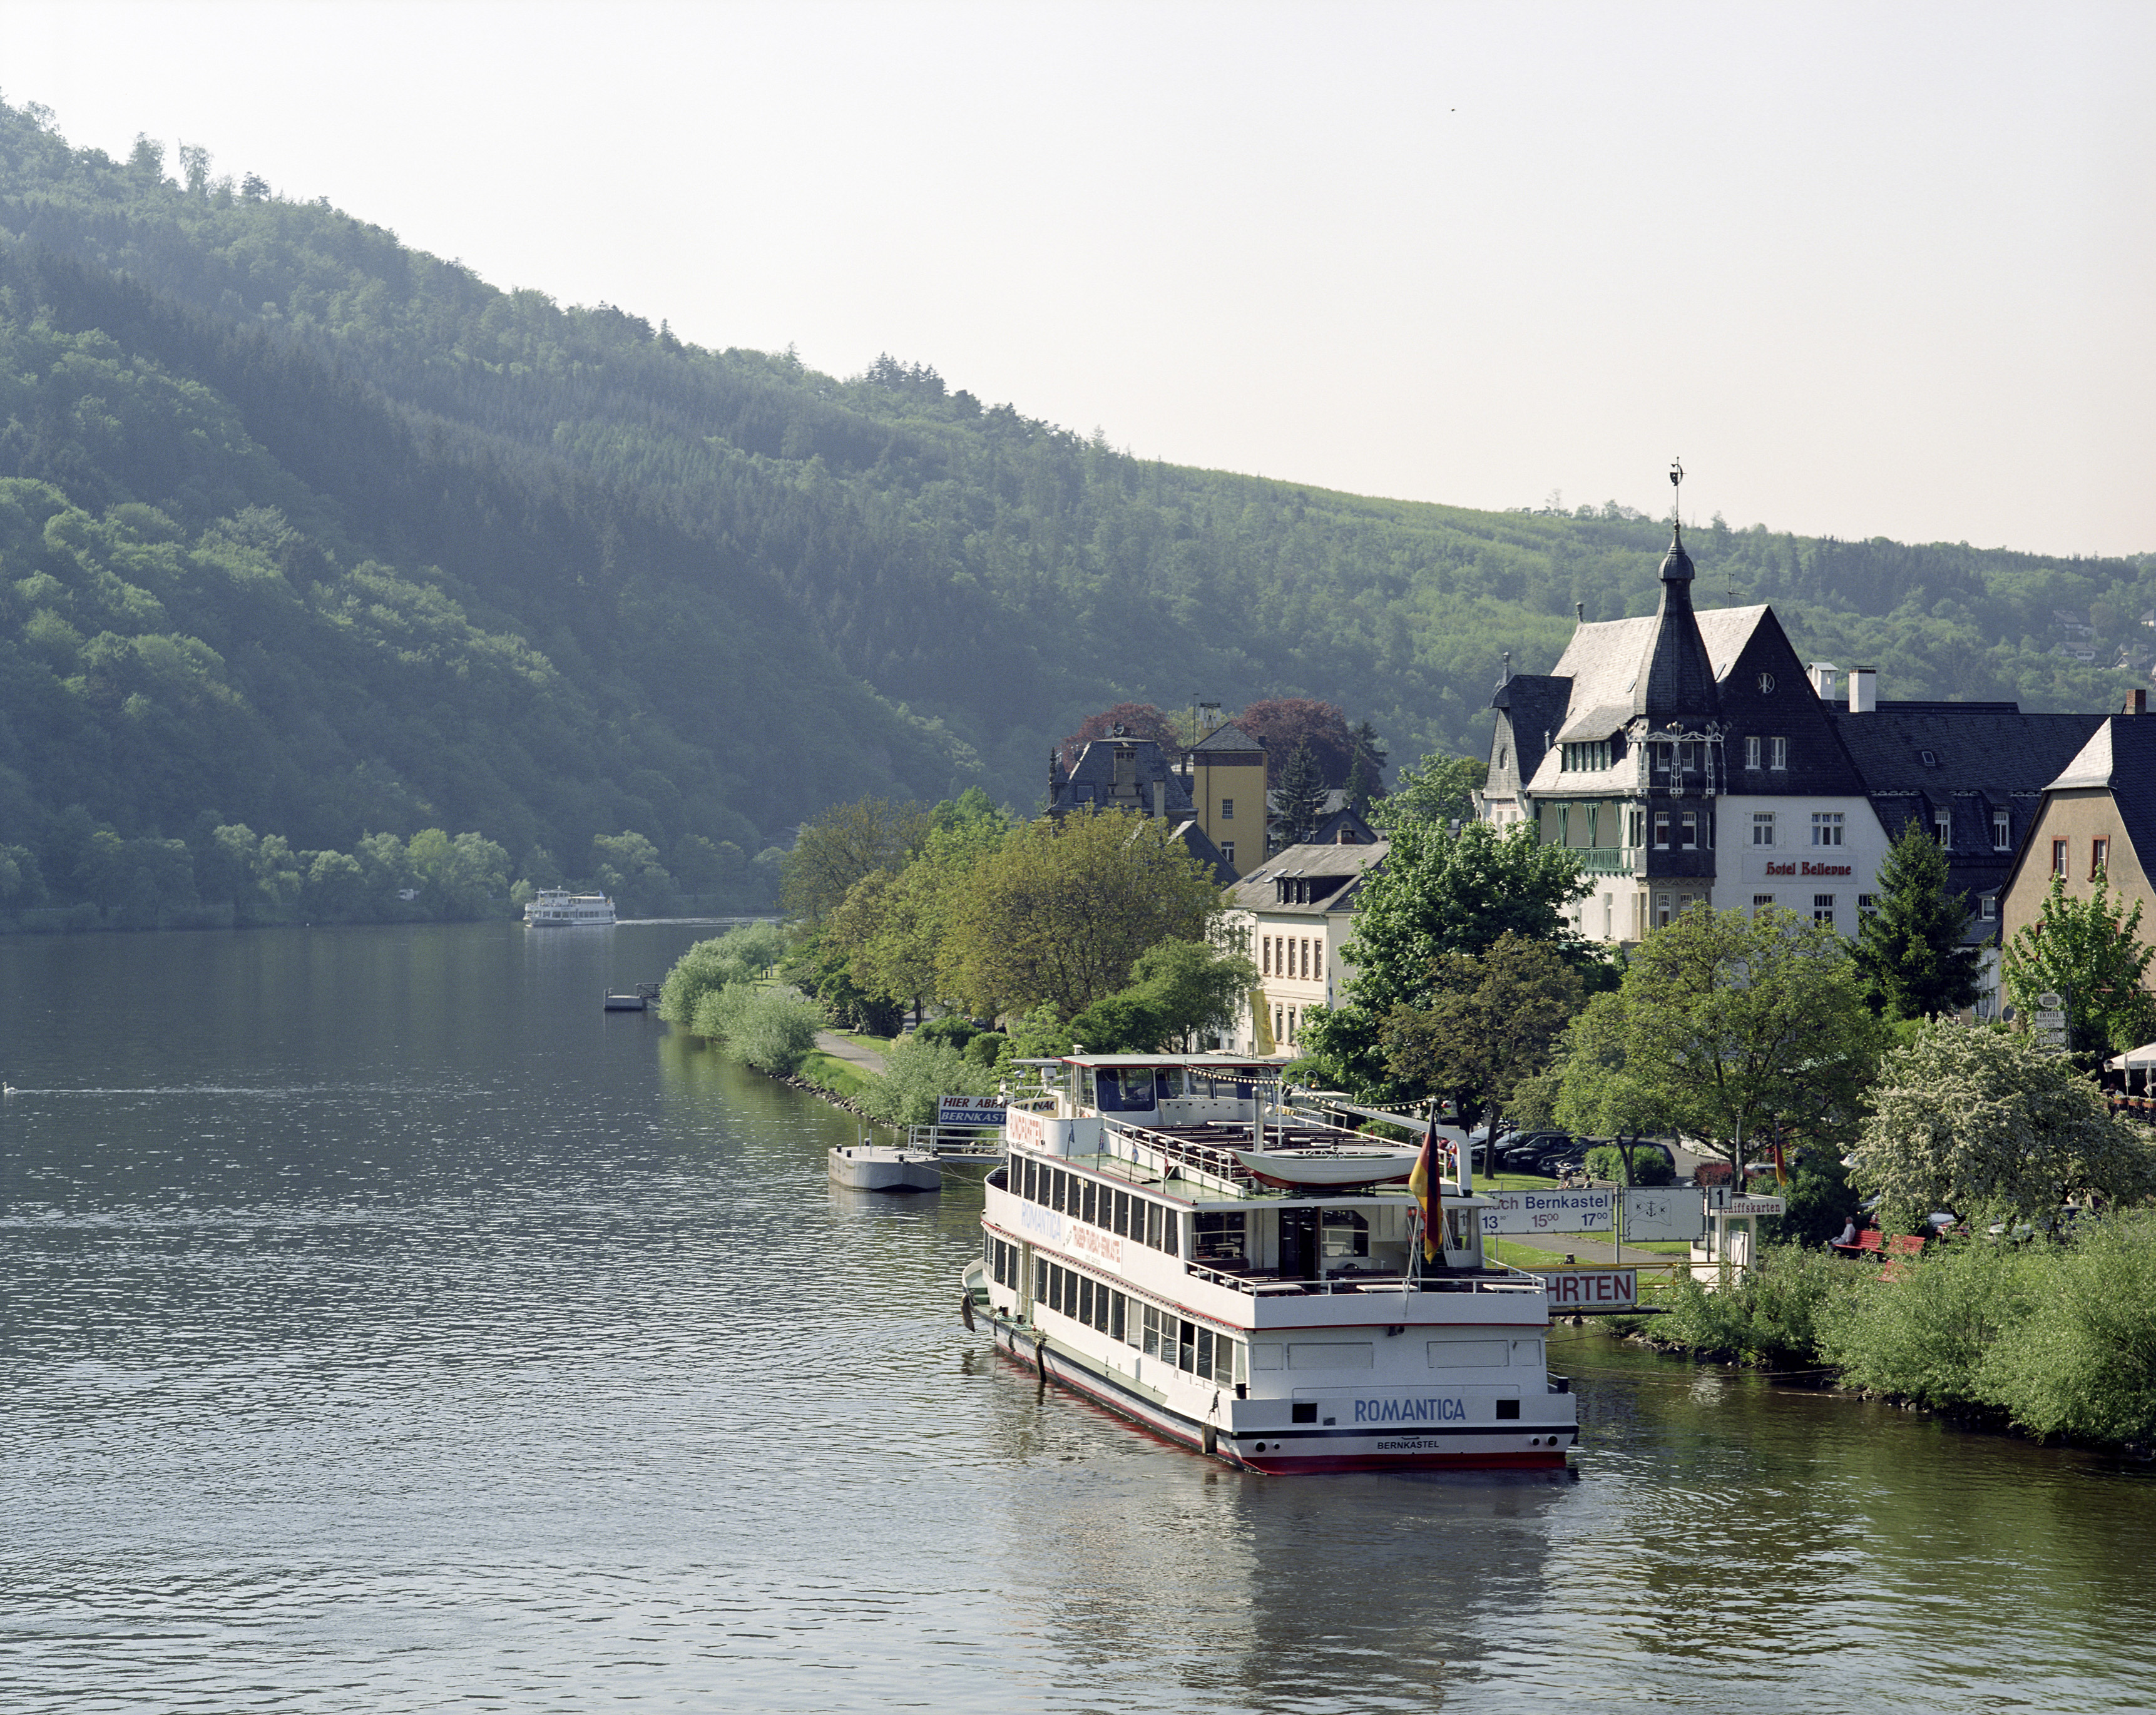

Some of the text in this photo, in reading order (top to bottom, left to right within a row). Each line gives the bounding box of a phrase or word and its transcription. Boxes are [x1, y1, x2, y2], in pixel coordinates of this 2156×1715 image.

[1765, 862, 1852, 875] Hotel Bellevue
[943, 1097, 969, 1107] HIER
[1525, 1194, 1608, 1209] Bernkastel
[1716, 1189, 1724, 1206] 1
[1021, 1201, 1061, 1241] ROMANTICA
[1355, 1398, 1466, 1422] ROMANTICA
[1377, 1441, 1439, 1449] BERNKASTEL
